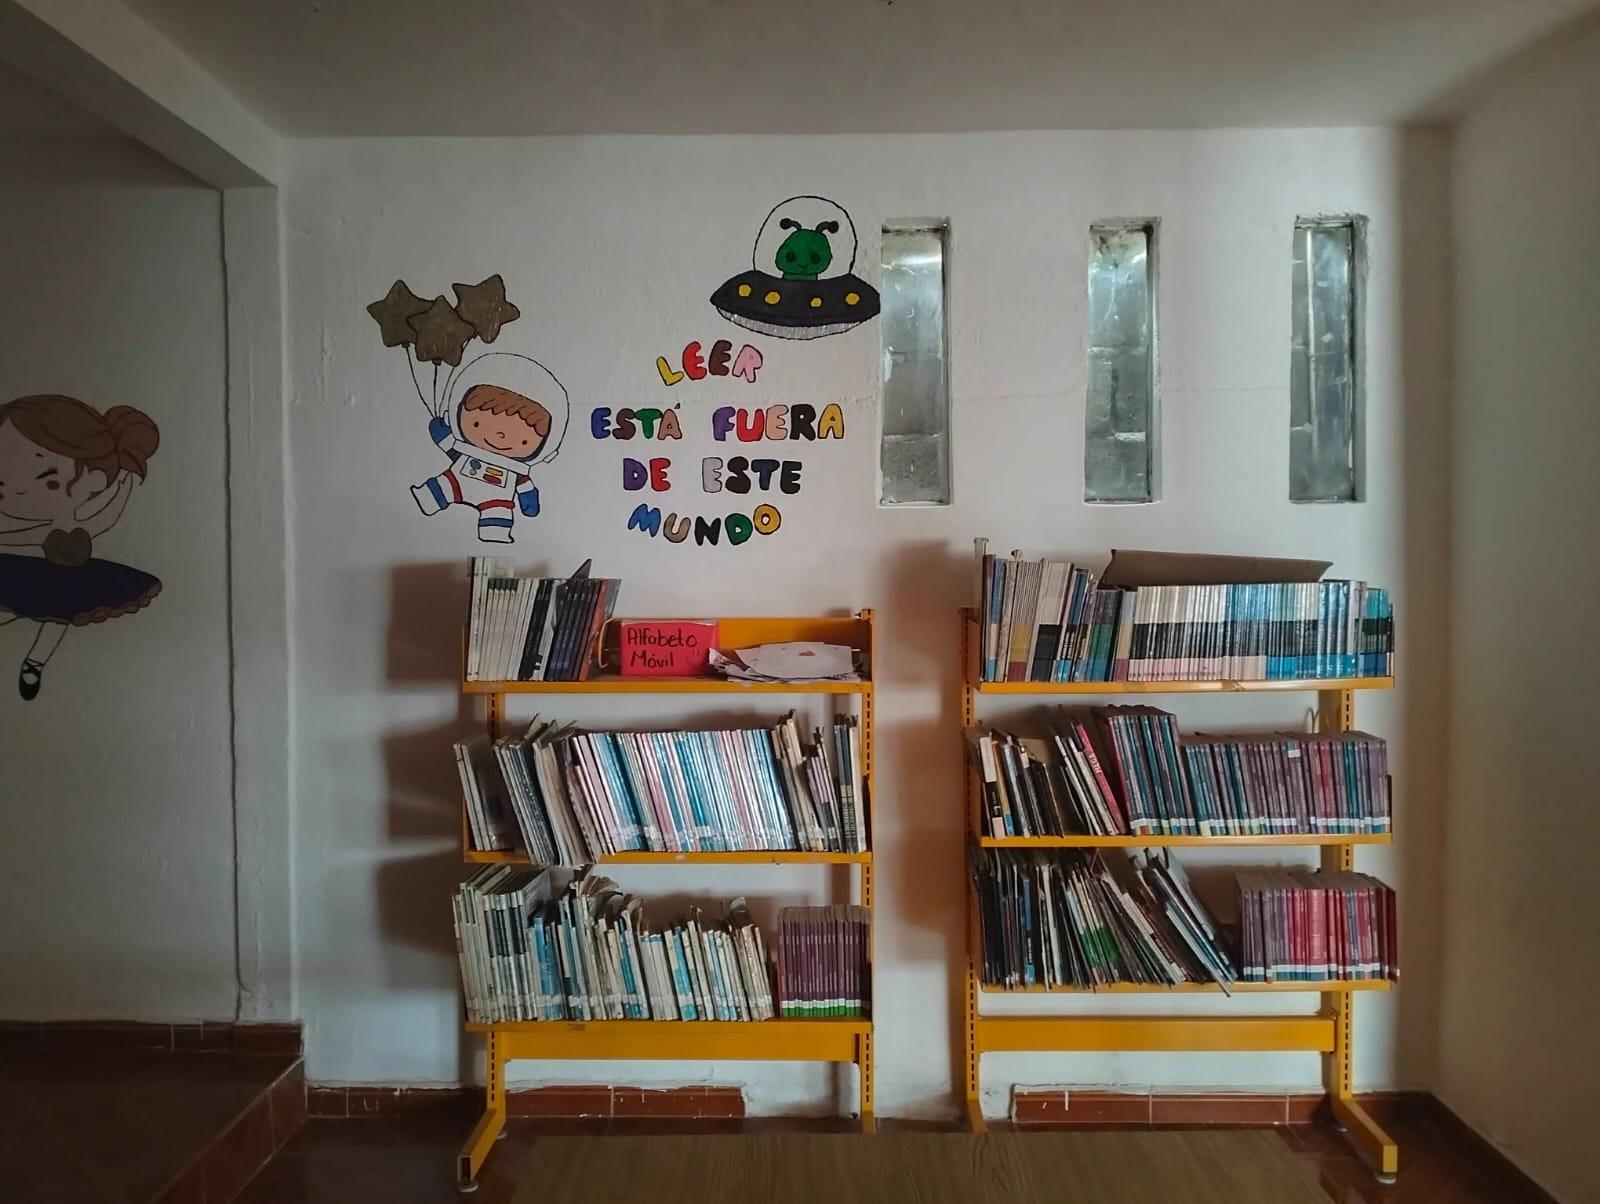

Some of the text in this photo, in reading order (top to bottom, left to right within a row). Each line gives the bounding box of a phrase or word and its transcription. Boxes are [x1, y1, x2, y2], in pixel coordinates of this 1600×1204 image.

[656, 340, 763, 386] LEER
[591, 403, 844, 442] ESTÁ FUERA
[623, 456, 802, 494] DE ESTE
[627, 503, 781, 546] MUNDO
[627, 627, 698, 648] Alfabeto
[630, 650, 674, 669] Móvil
